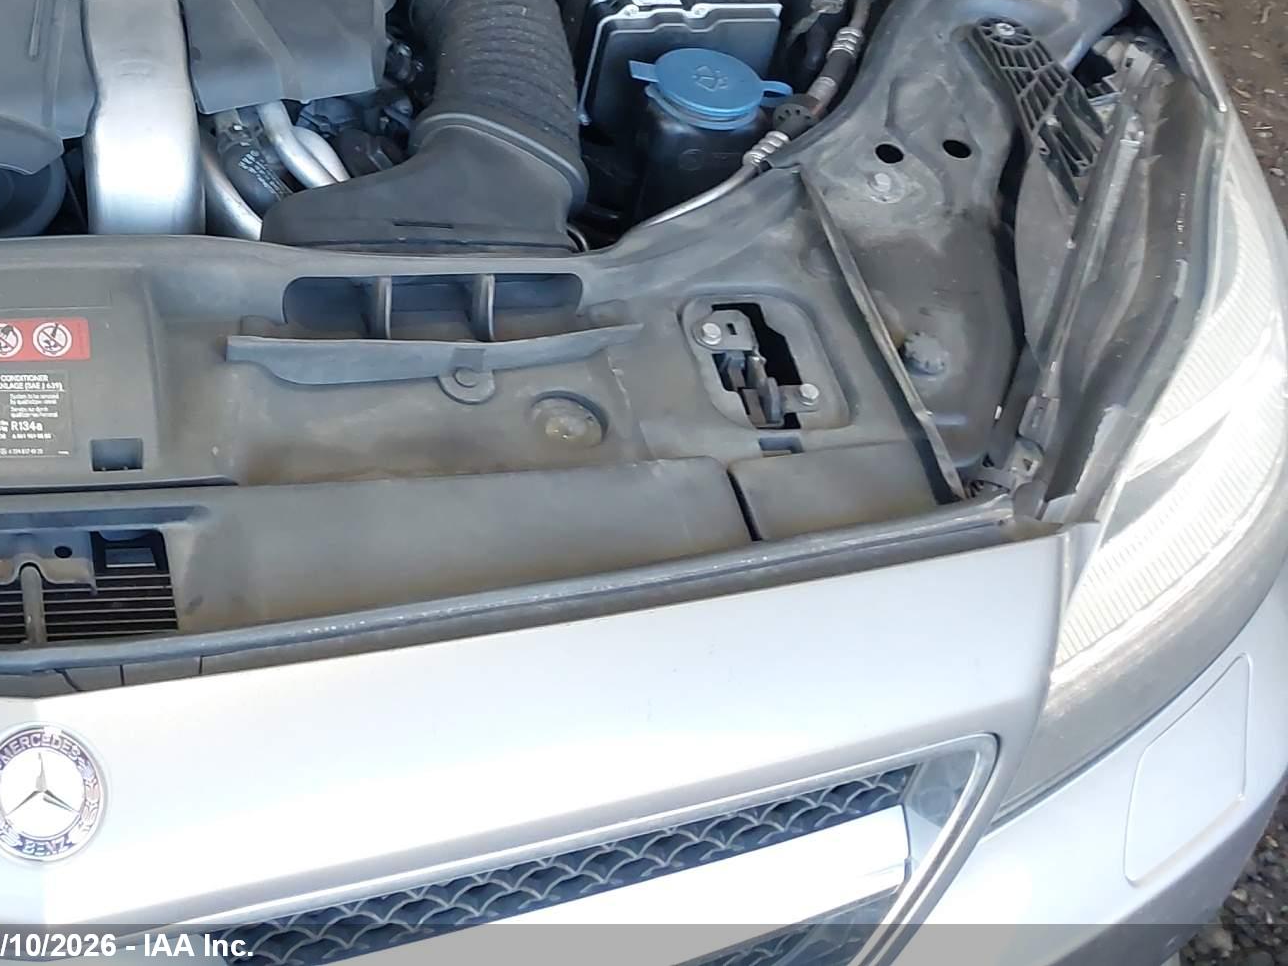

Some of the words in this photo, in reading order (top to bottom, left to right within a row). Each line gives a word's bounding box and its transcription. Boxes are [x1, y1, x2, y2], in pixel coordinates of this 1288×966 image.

[0, 374, 49, 382] CONDITIONER
[11, 420, 43, 432] R134a
[22, 837, 75, 855] BENZ
